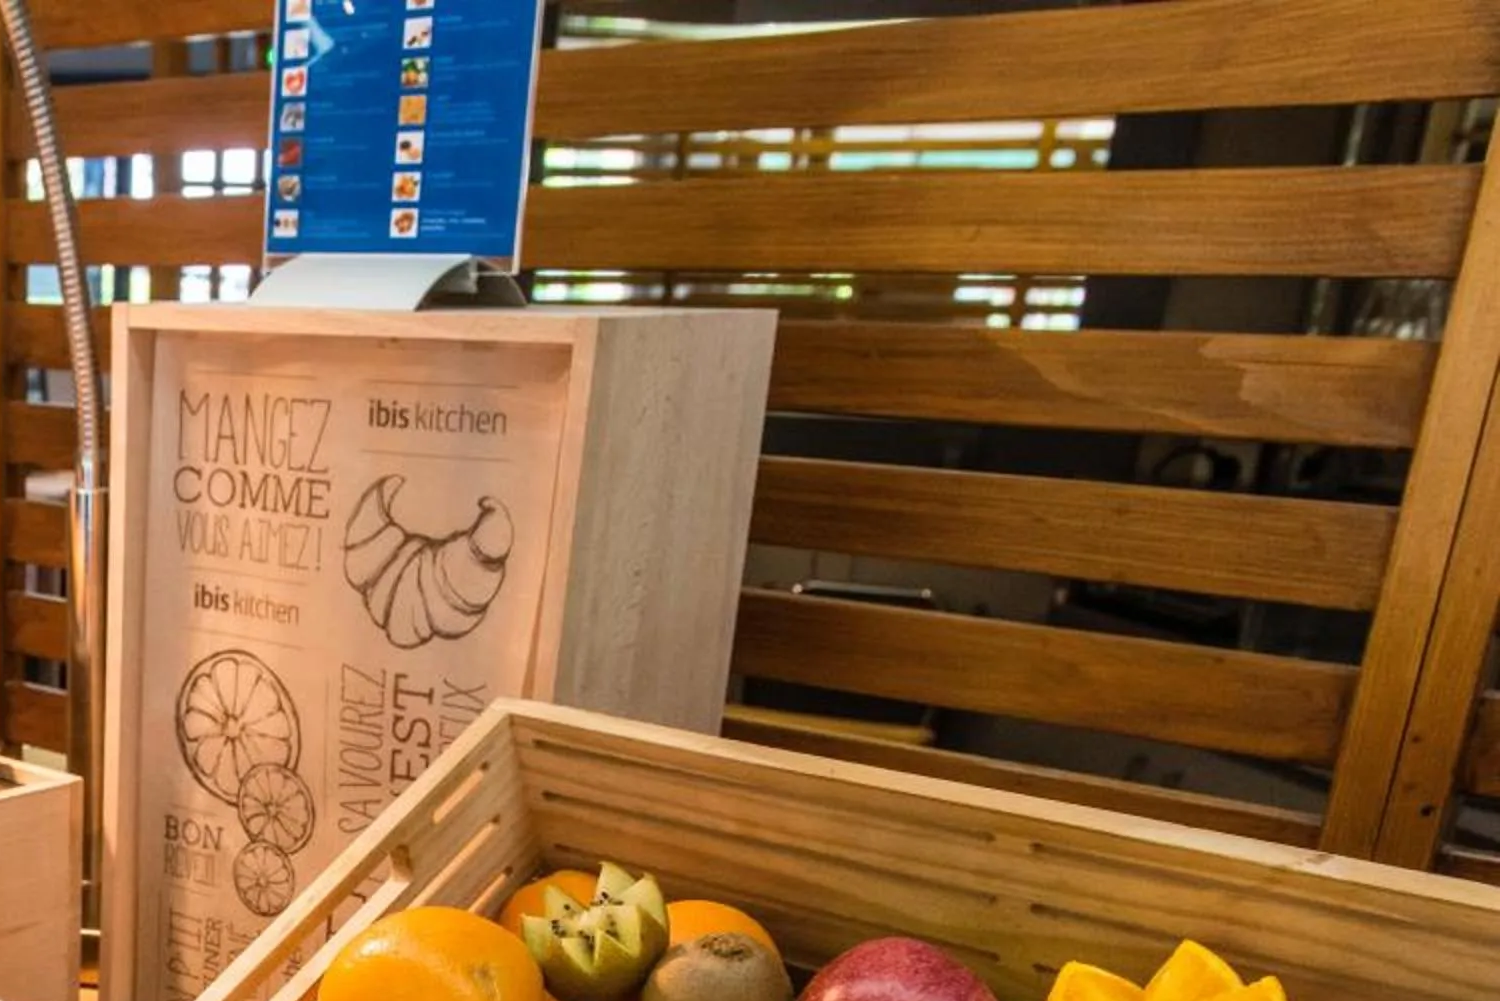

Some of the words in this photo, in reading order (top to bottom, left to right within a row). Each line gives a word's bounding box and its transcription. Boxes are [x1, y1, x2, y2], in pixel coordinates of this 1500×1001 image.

[177, 389, 332, 474] MANGEZ
[368, 400, 410, 430] ibis
[414, 402, 508, 435] kitchen
[173, 466, 331, 519] COMME
[174, 510, 229, 558] VOUS
[194, 584, 230, 612] ibis
[233, 588, 300, 626] kitchen
[337, 662, 387, 834] SAVOUREZ
[164, 814, 224, 850] BON
